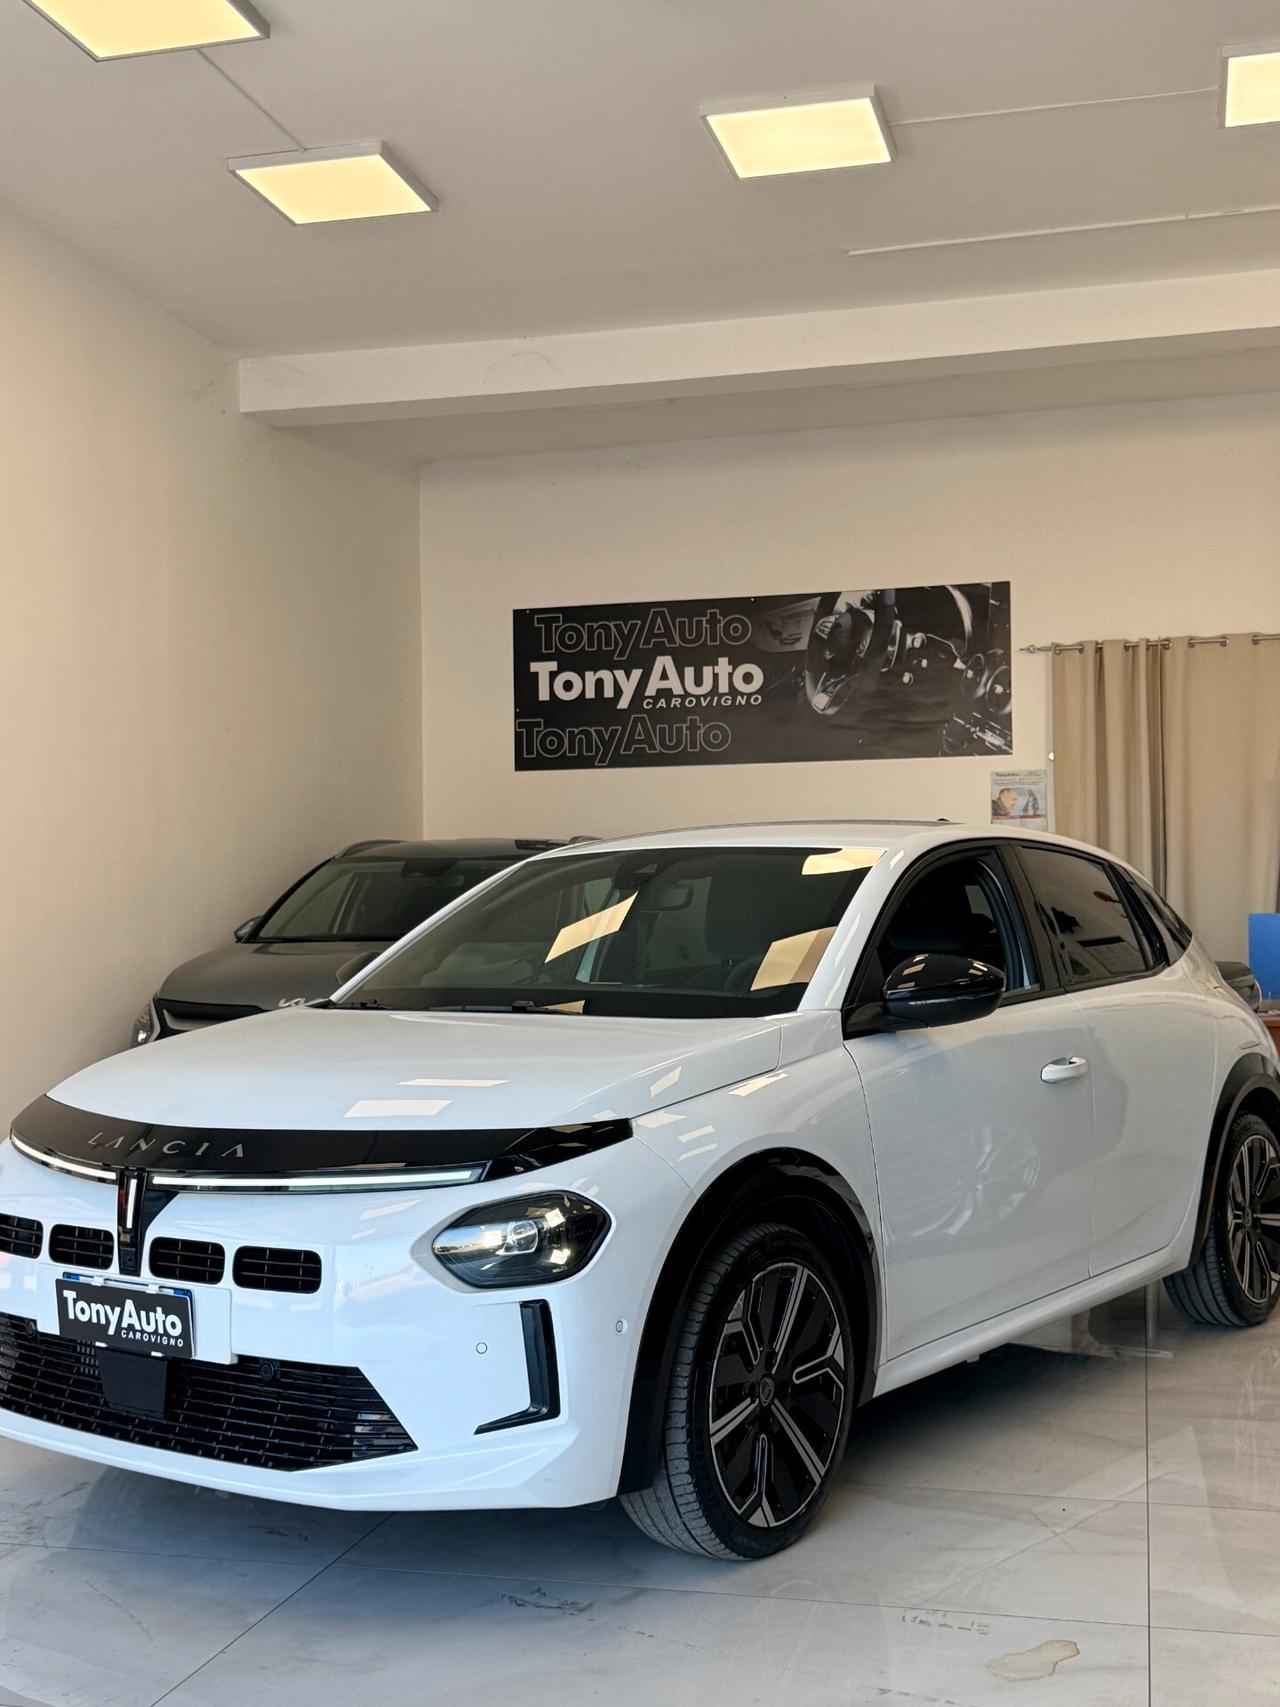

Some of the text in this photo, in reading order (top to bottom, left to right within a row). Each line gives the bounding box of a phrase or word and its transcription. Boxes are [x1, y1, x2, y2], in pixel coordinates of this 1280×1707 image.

[535, 608, 752, 660] TonyAuto
[530, 655, 764, 709] TonyAuto
[642, 694, 763, 710] CAROVIGNO
[516, 714, 732, 766] TonyAuto
[87, 1132, 244, 1157] LANCIA
[63, 1289, 182, 1336] TonyAuto
[121, 1329, 184, 1348] CAROVIGNO
